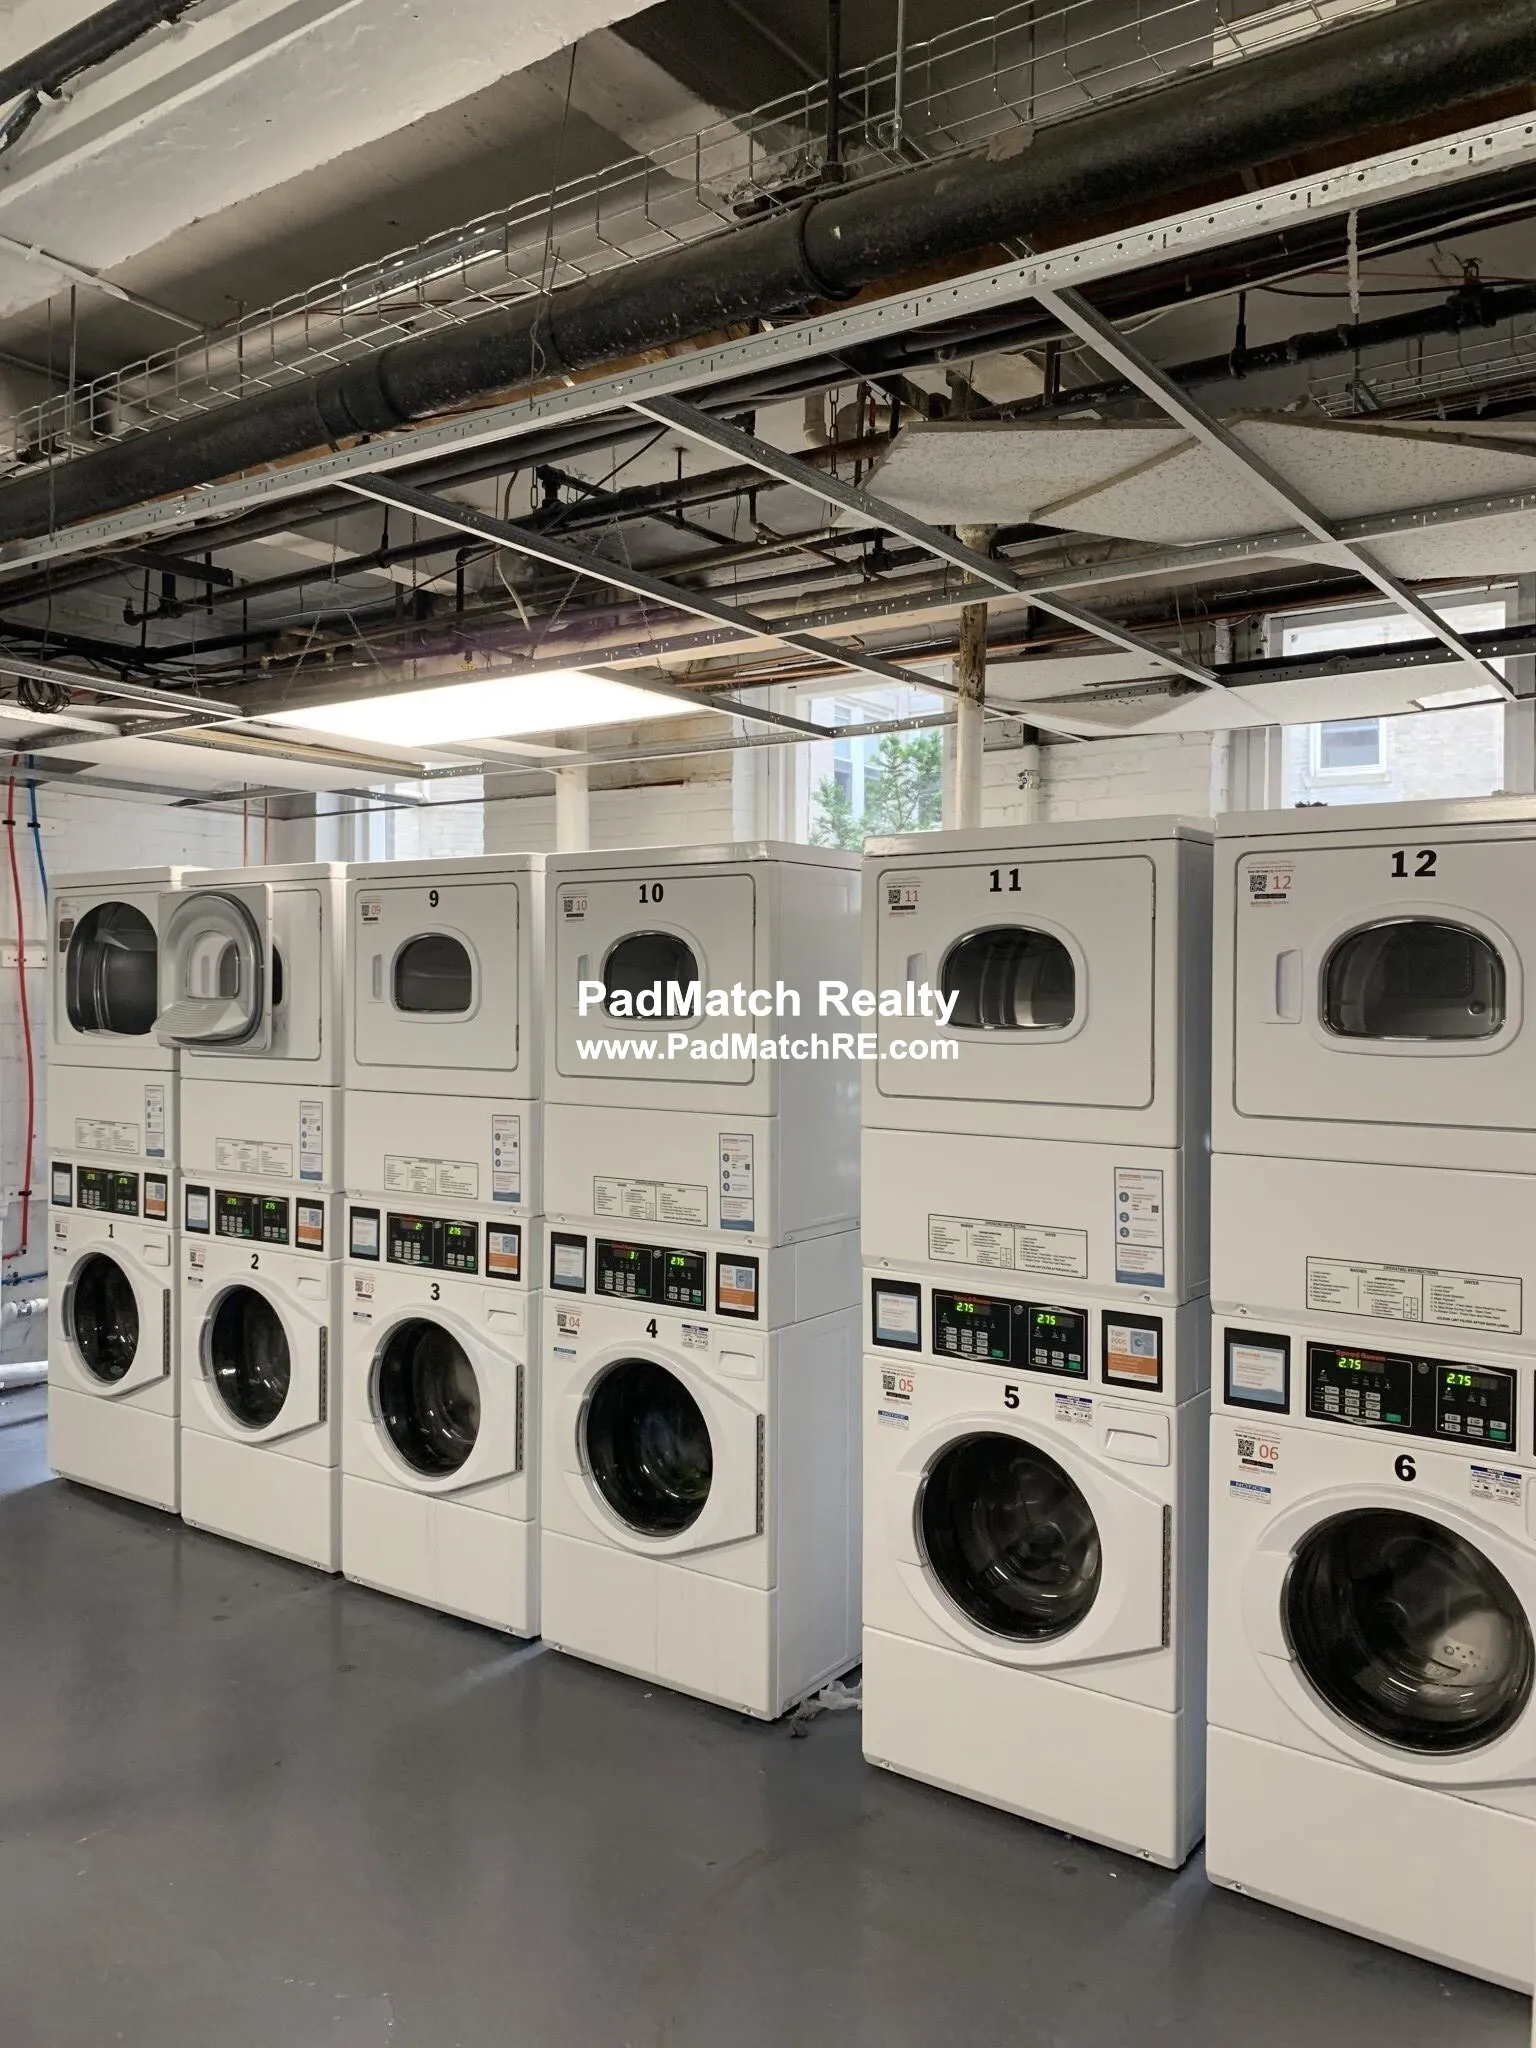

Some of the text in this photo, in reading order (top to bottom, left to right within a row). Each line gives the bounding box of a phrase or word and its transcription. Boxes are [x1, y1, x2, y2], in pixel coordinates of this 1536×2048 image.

[1390, 849, 1437, 878] 12
[989, 868, 1022, 893] 11
[1272, 875, 1292, 890] 12
[429, 889, 440, 908] 9
[638, 882, 664, 904] 10
[905, 890, 920, 902] 11
[575, 900, 588, 911] 10
[108, 1223, 114, 1239] 1
[250, 1253, 259, 1270] 2
[430, 1282, 440, 1301] 3
[569, 1316, 580, 1329] 04
[646, 1318, 659, 1339] 4
[1338, 1357, 1362, 1370] 2.75
[898, 1378, 914, 1393] 05
[1446, 1372, 1472, 1387] 2.75
[1003, 1384, 1020, 1409] 5
[1259, 1444, 1279, 1461] 06
[1394, 1454, 1417, 1482] 6
